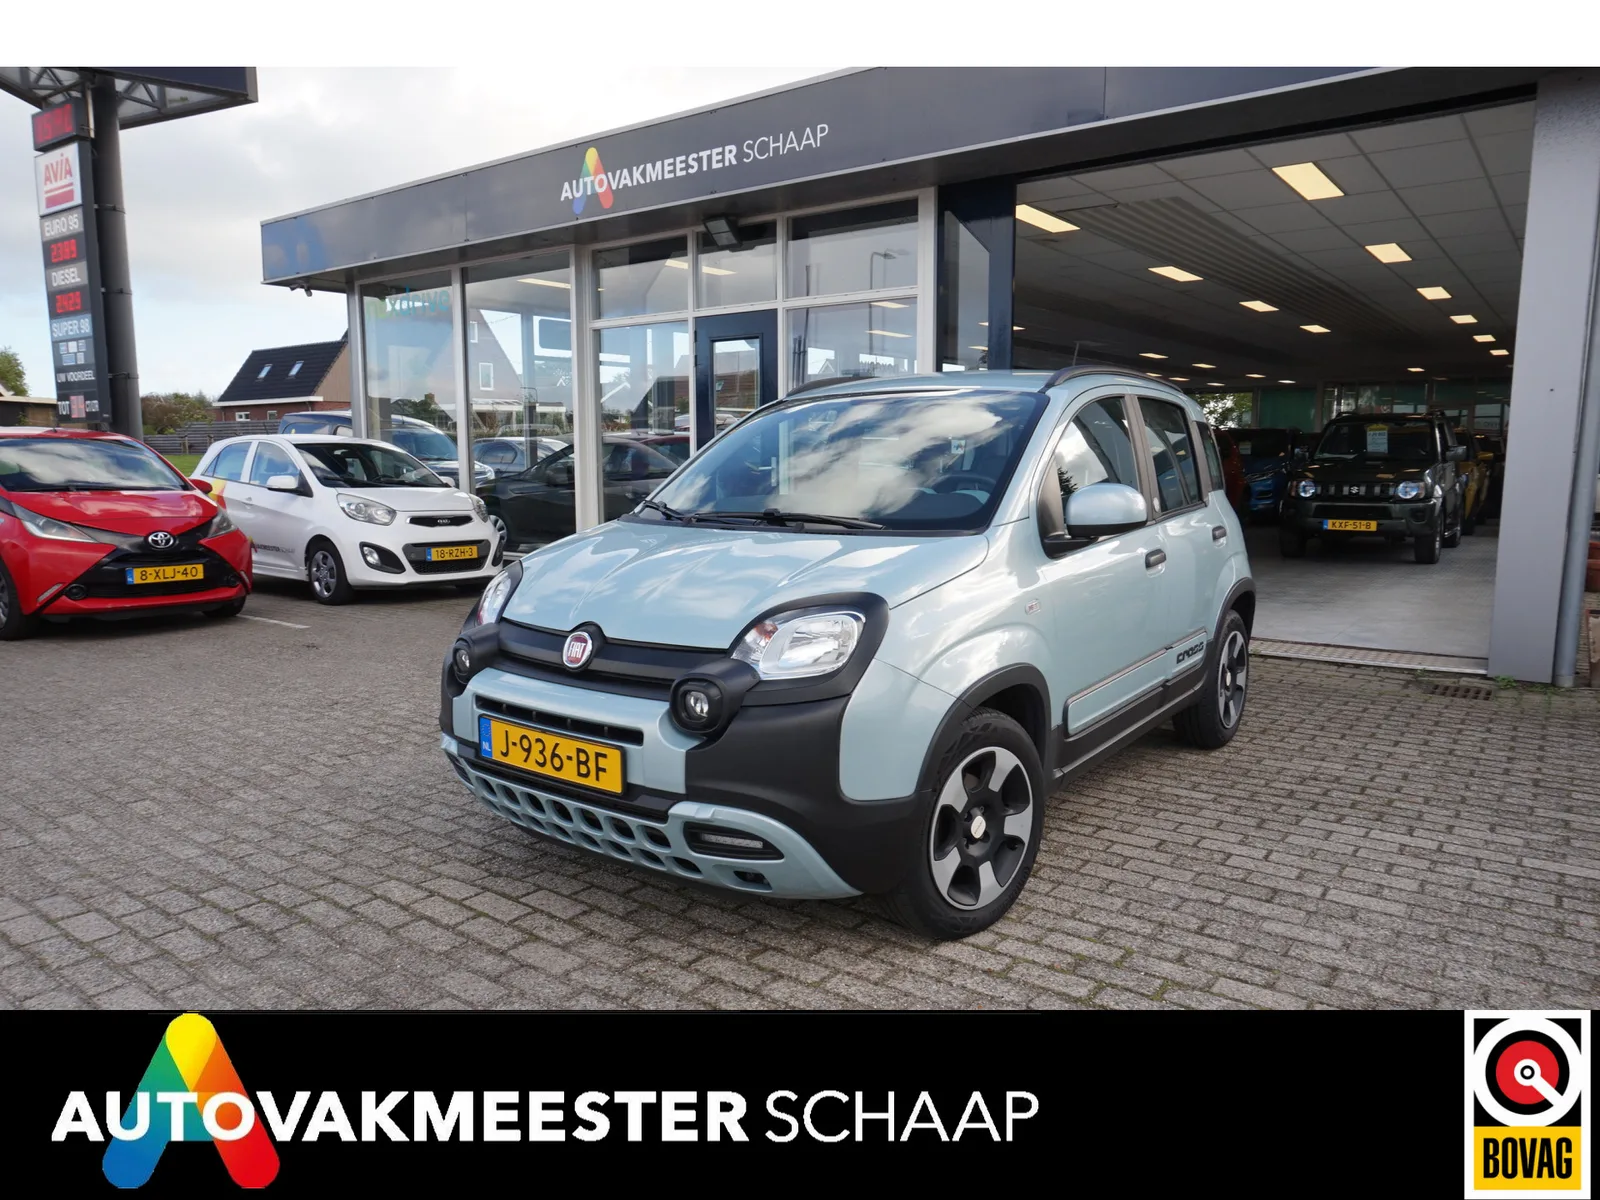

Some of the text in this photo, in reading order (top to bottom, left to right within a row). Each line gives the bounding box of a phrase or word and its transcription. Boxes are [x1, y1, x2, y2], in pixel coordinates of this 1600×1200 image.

[560, 123, 829, 201] AUTOVAKMEESTER SCHAAP
[44, 213, 79, 237] EURO 95
[51, 267, 81, 287] DIESEL
[52, 320, 79, 337] SUPER
[66, 370, 95, 382] VOORDEEL
[57, 401, 70, 415] TOT
[435, 547, 474, 559] 18-RZH-3
[140, 566, 198, 581] 8-XLJ-40
[568, 641, 587, 659] FIAT
[500, 729, 608, 782] J-936-BF
